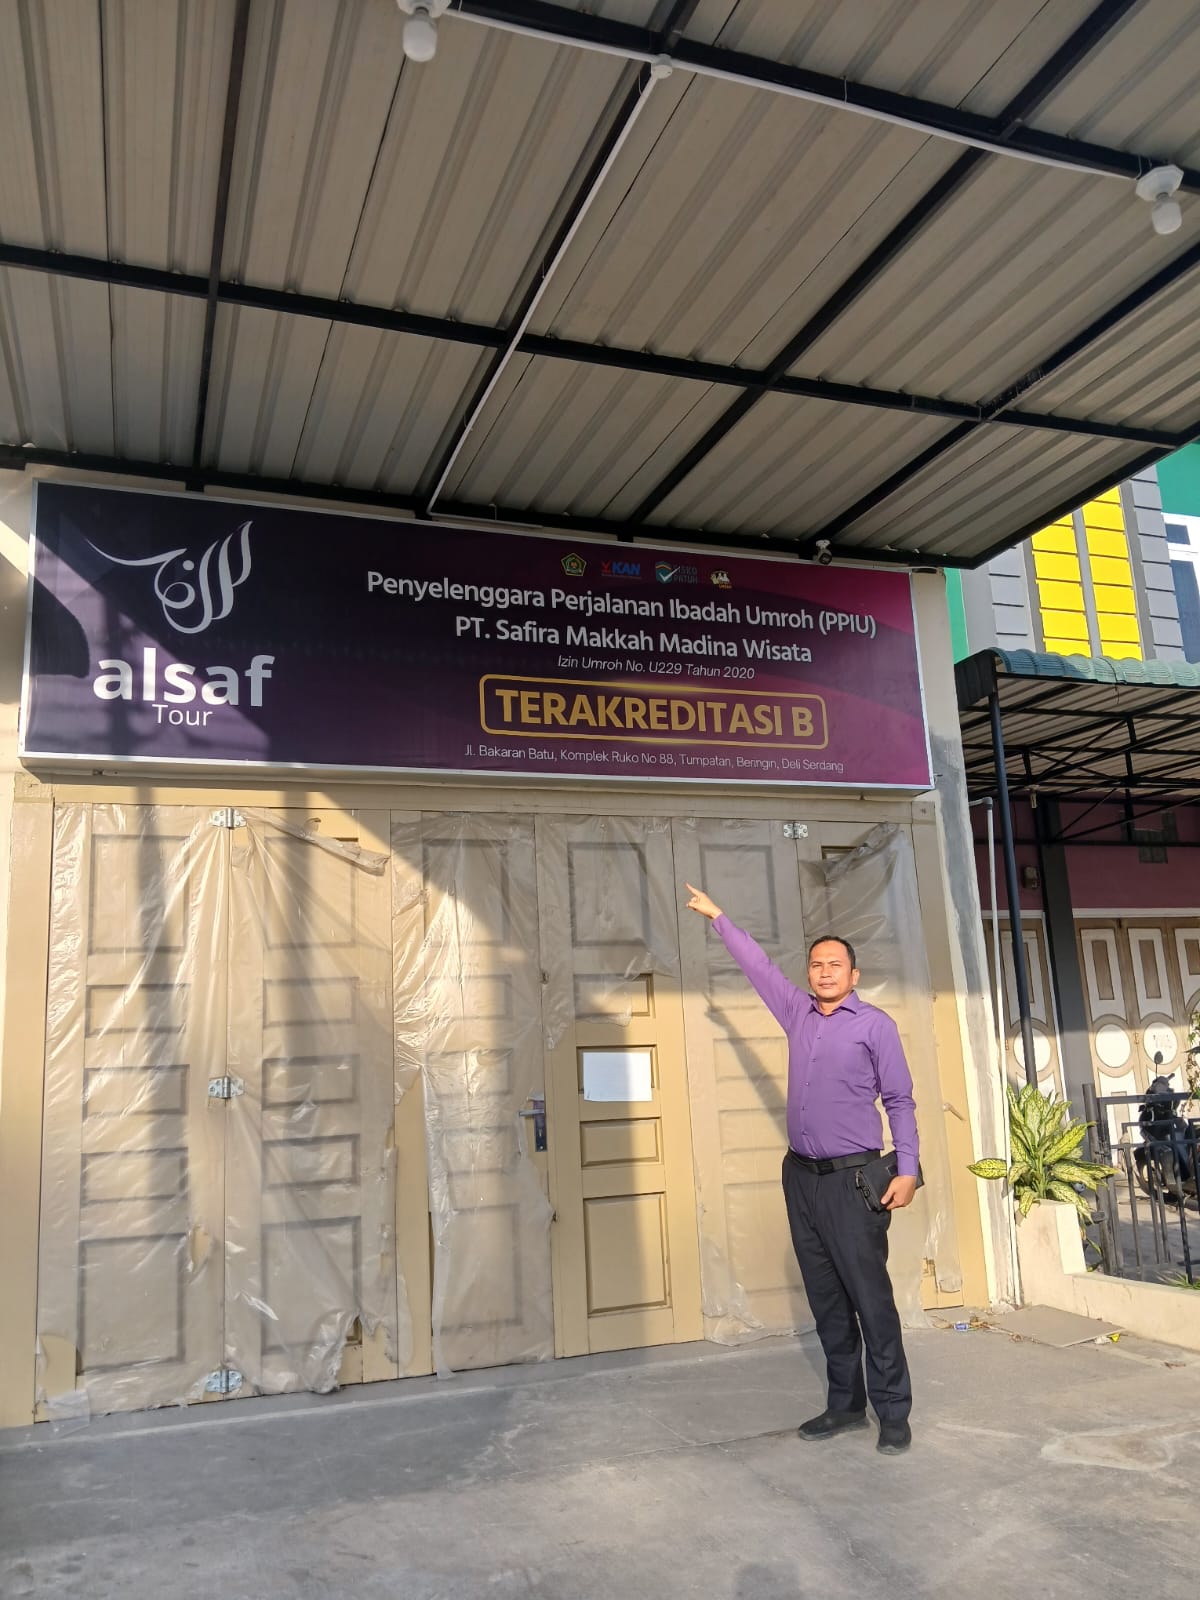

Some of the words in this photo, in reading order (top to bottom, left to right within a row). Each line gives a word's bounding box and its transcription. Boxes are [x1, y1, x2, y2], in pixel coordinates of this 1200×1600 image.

[612, 561, 640, 577] KAN
[367, 571, 545, 608] Penyelenggara
[551, 588, 664, 617] Perjalanan
[670, 598, 741, 624] Ibadah
[746, 605, 814, 629] Umroh
[818, 611, 876, 638] (PPIU)
[456, 615, 490, 639] PT.
[496, 619, 560, 645] Safira
[566, 625, 653, 651] Makkah
[659, 632, 738, 657] Madina
[743, 638, 812, 662] Wisata
[93, 647, 275, 707] alsaf
[558, 655, 579, 668] Izin
[582, 656, 622, 671] Umroh
[625, 659, 646, 673] No.
[649, 661, 682, 675] U229
[686, 664, 721, 677] Tahun
[723, 666, 755, 680] 2020
[152, 704, 213, 726] Tour
[495, 688, 783, 736] TERAKREDITASI
[791, 705, 815, 738] B
[479, 744, 526, 759] Bakaran
[528, 747, 558, 762] Batu,
[560, 749, 609, 763] Komplek
[612, 751, 639, 764] Ruko
[641, 752, 657, 764] No
[679, 753, 734, 769] Tumpatan,
[736, 756, 780, 771] Beringin,
[782, 758, 801, 770] Deli
[802, 759, 844, 773] Serdang
